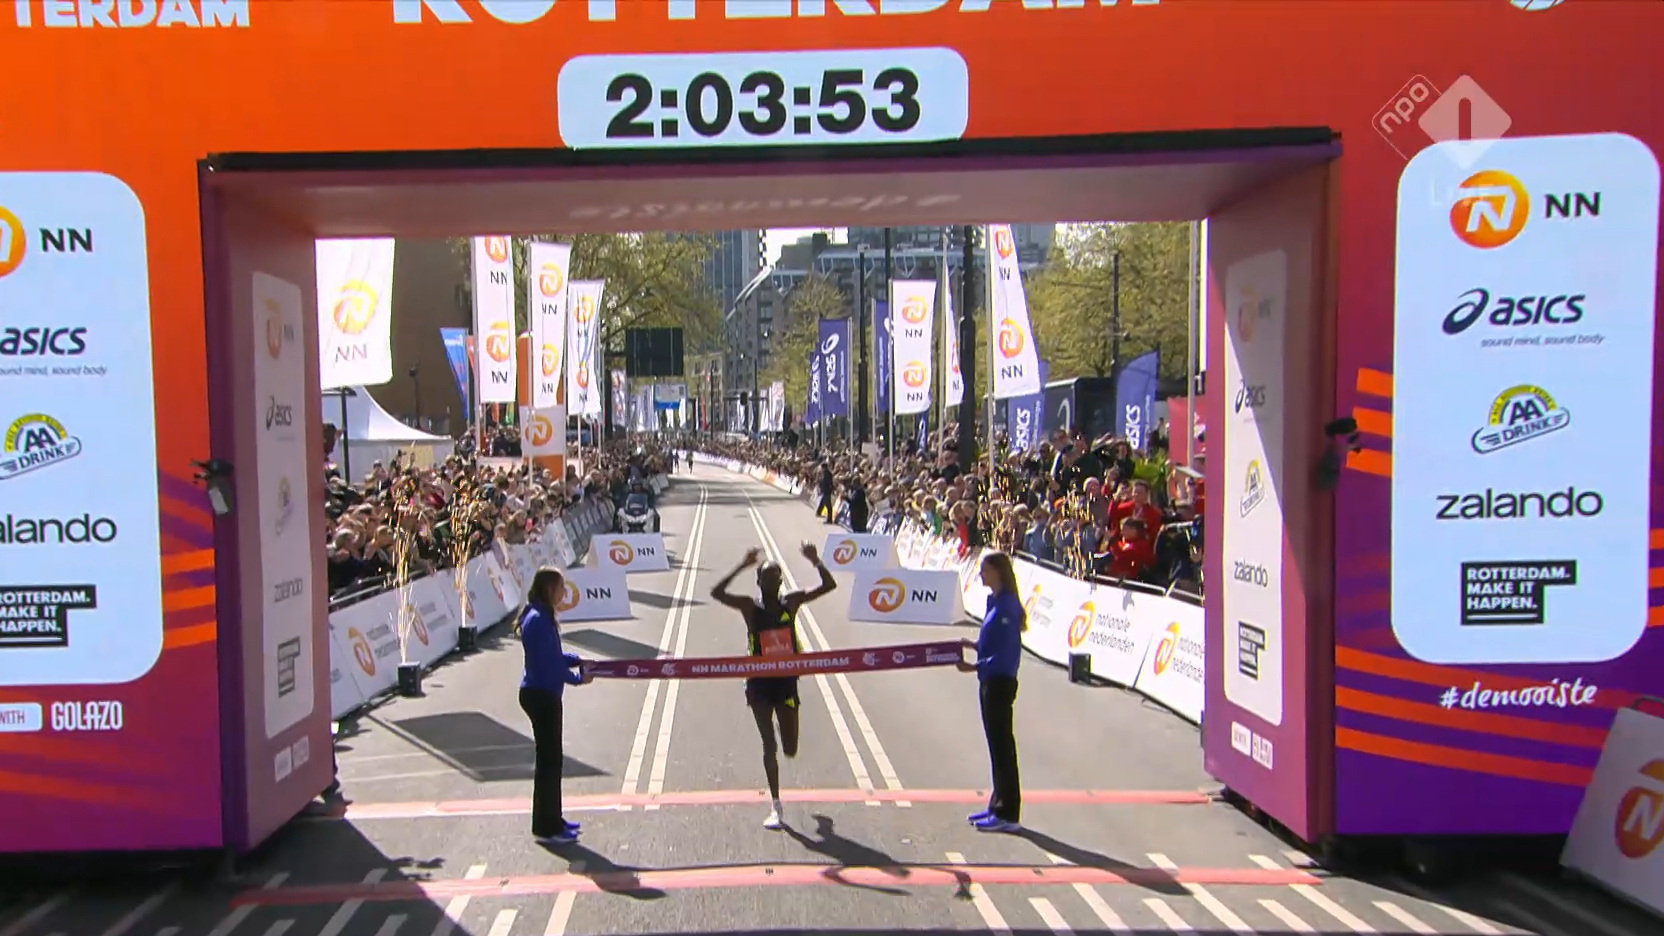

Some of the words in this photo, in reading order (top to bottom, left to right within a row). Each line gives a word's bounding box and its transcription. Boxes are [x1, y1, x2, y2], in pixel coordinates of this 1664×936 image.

[606, 67, 920, 137] 2:03:53
[1544, 191, 1601, 218] NN
[40, 227, 93, 253] NN
[905, 328, 923, 338] NN
[334, 343, 368, 364] NN
[1001, 364, 1023, 380] NN
[907, 391, 923, 401] NN
[1508, 399, 1544, 426] AA
[24, 427, 56, 453] AA
[1502, 418, 1550, 443] DRINK
[18, 446, 65, 469] DRINK
[1436, 486, 1604, 520] zalando
[0, 513, 118, 544] lando
[636, 546, 655, 556] NN
[860, 548, 877, 558] NN
[1467, 567, 1571, 581] ROTTERDAM.
[586, 586, 612, 600] NN
[911, 589, 937, 603] NN
[1467, 582, 1514, 595] MAKE
[1520, 582, 1535, 594] IT
[44, 604, 58, 617] IT
[1467, 597, 1538, 610] HAPPEN.
[1097, 613, 1131, 632] nationale
[1090, 631, 1135, 655] nederlanden
[692, 665, 709, 674] NN
[711, 662, 774, 673] MARATHON
[778, 657, 849, 670] ROTTERDAM
[1440, 677, 1599, 710] #demooiste
[51, 701, 123, 731] GOLAZO
